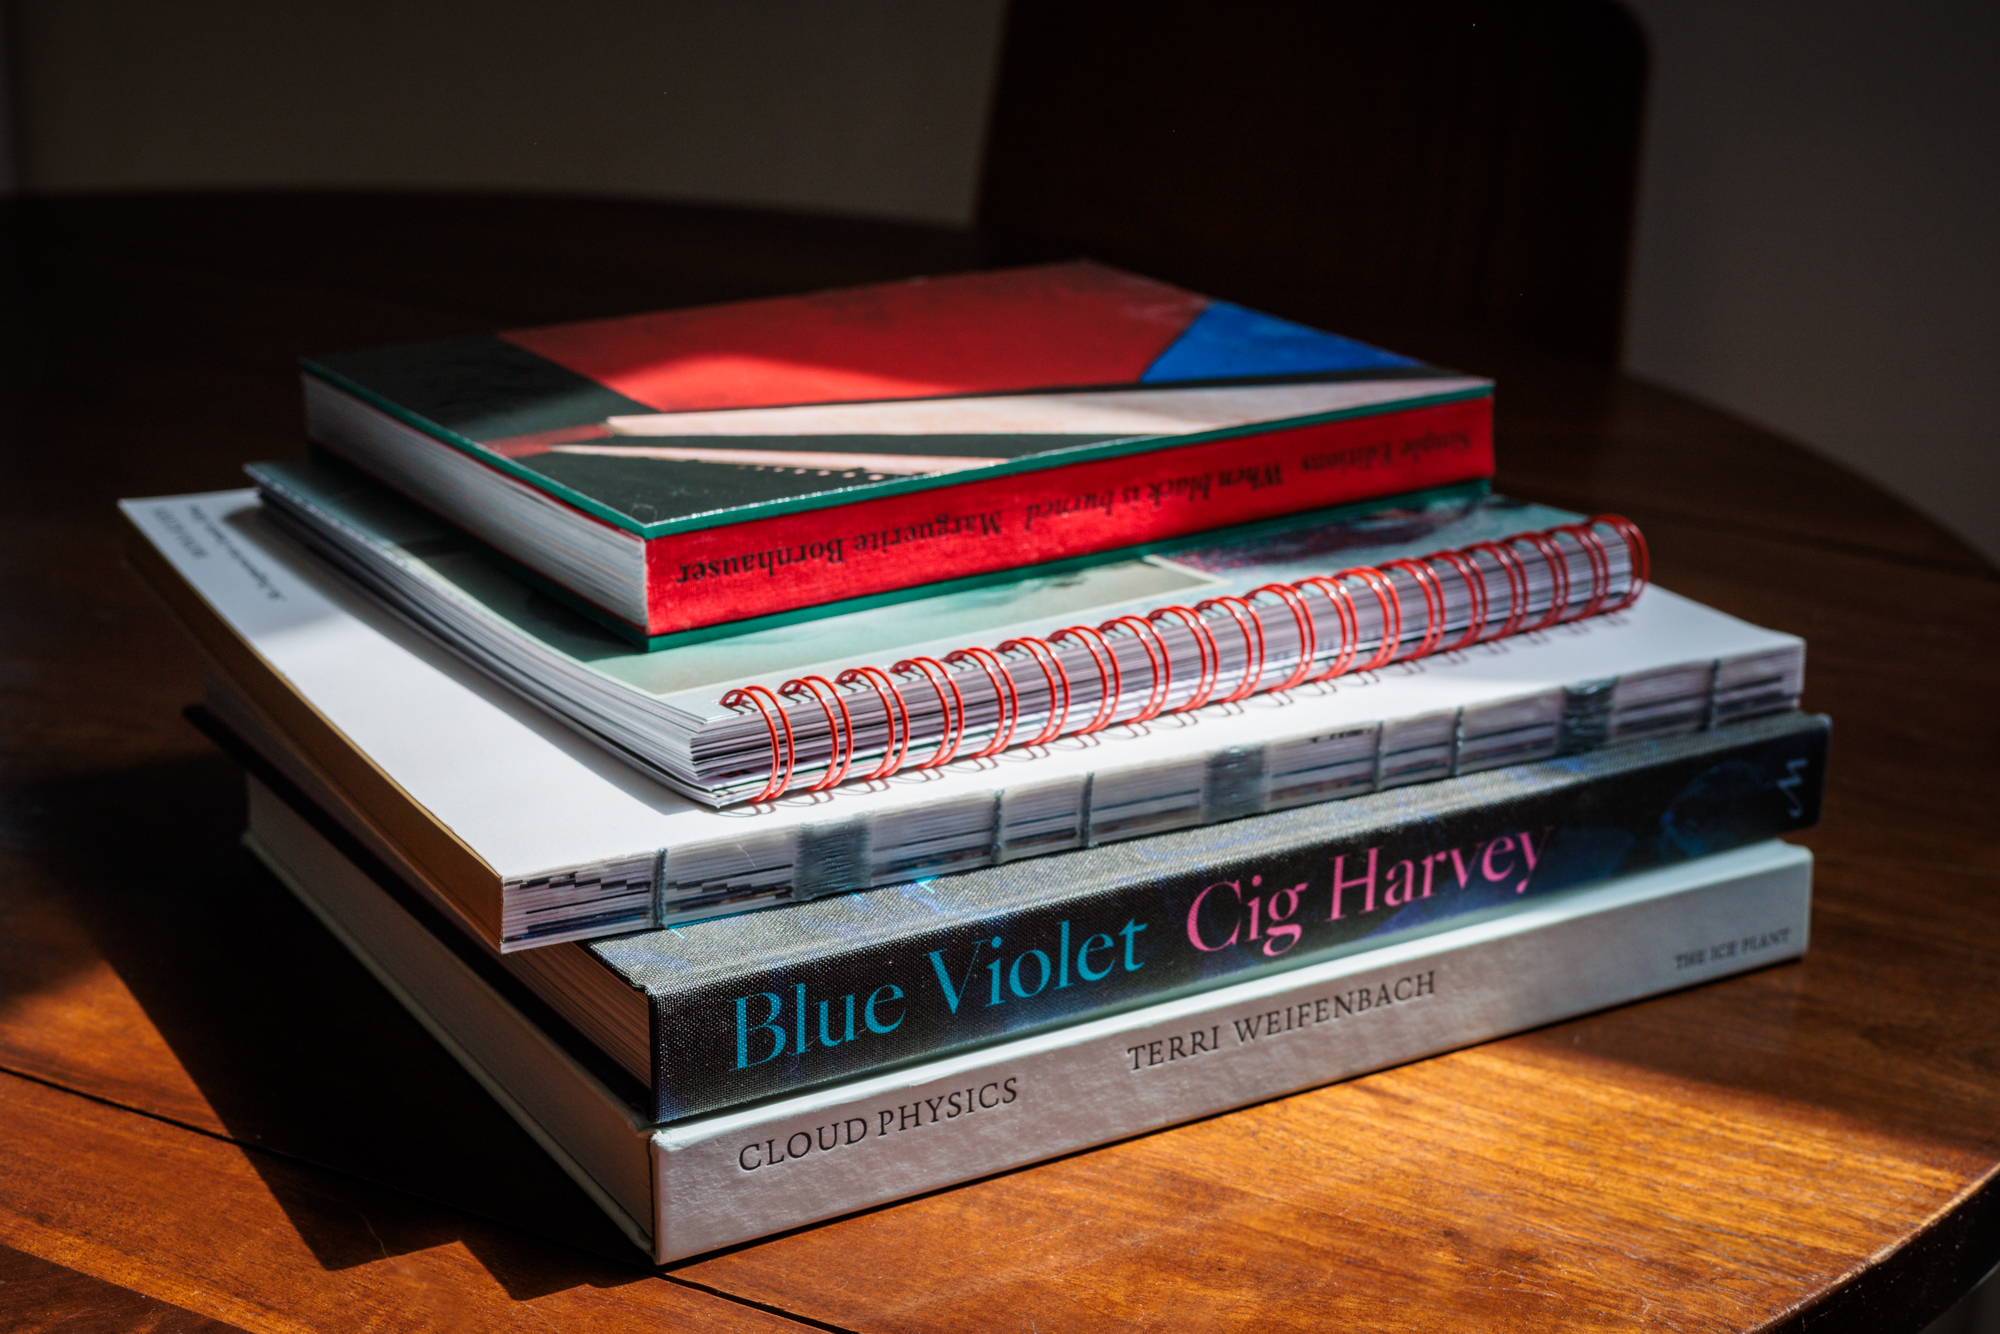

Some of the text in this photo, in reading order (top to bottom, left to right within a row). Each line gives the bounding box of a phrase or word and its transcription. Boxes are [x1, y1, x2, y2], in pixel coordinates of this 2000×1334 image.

[1025, 462, 1283, 531] When black is burned
[1301, 442, 1393, 473] Editions
[676, 511, 1001, 584] Marguerite Bornhauser
[1186, 825, 1554, 957] Cig Harvey
[1674, 926, 1792, 970] THE ICE PLANT
[729, 917, 1148, 1072] Blue Violet
[1127, 970, 1436, 1071] TERRI WEIFENBACH
[738, 1077, 1018, 1171] CLOUD PHYSICS
